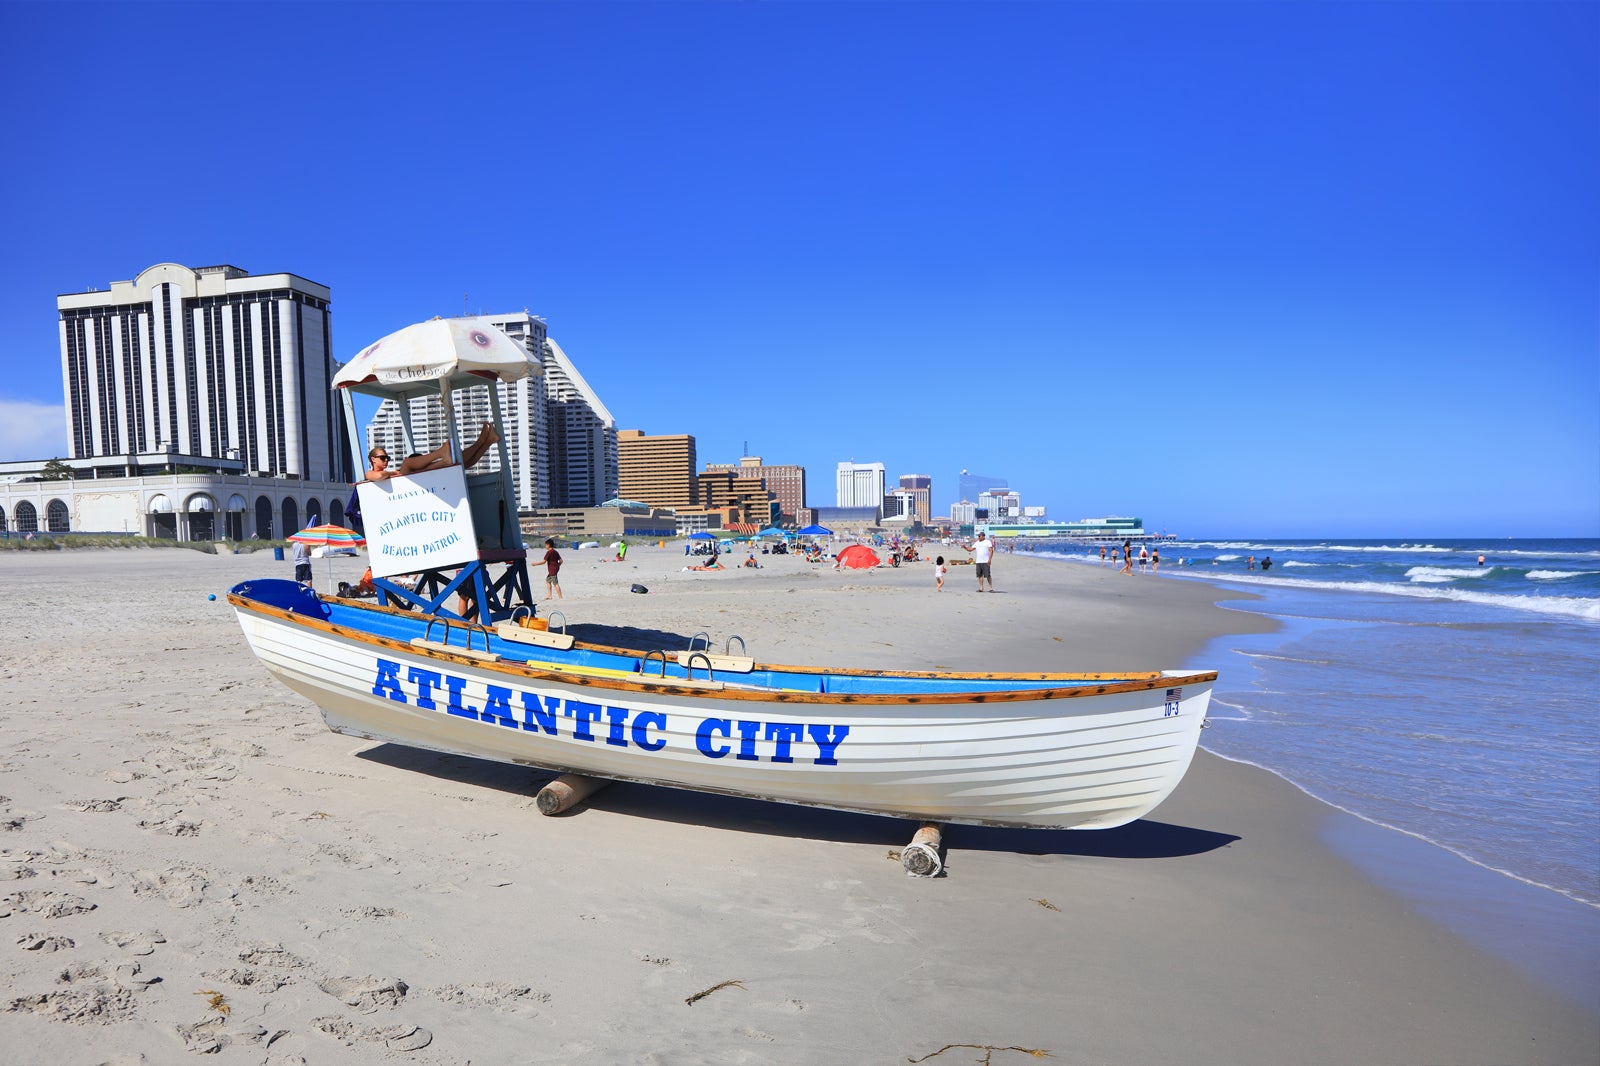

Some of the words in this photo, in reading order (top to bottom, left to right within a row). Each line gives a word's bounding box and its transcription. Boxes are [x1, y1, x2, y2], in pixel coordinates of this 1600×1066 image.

[398, 365, 447, 380] Chelsea
[379, 511, 428, 537] ATLANTIC
[431, 511, 457, 523] CITY
[382, 543, 418, 557] BEACH
[422, 531, 461, 555] PATROL
[371, 658, 667, 752] ATLANTIC
[695, 717, 850, 766] CITY
[1164, 701, 1180, 717] 10-3
